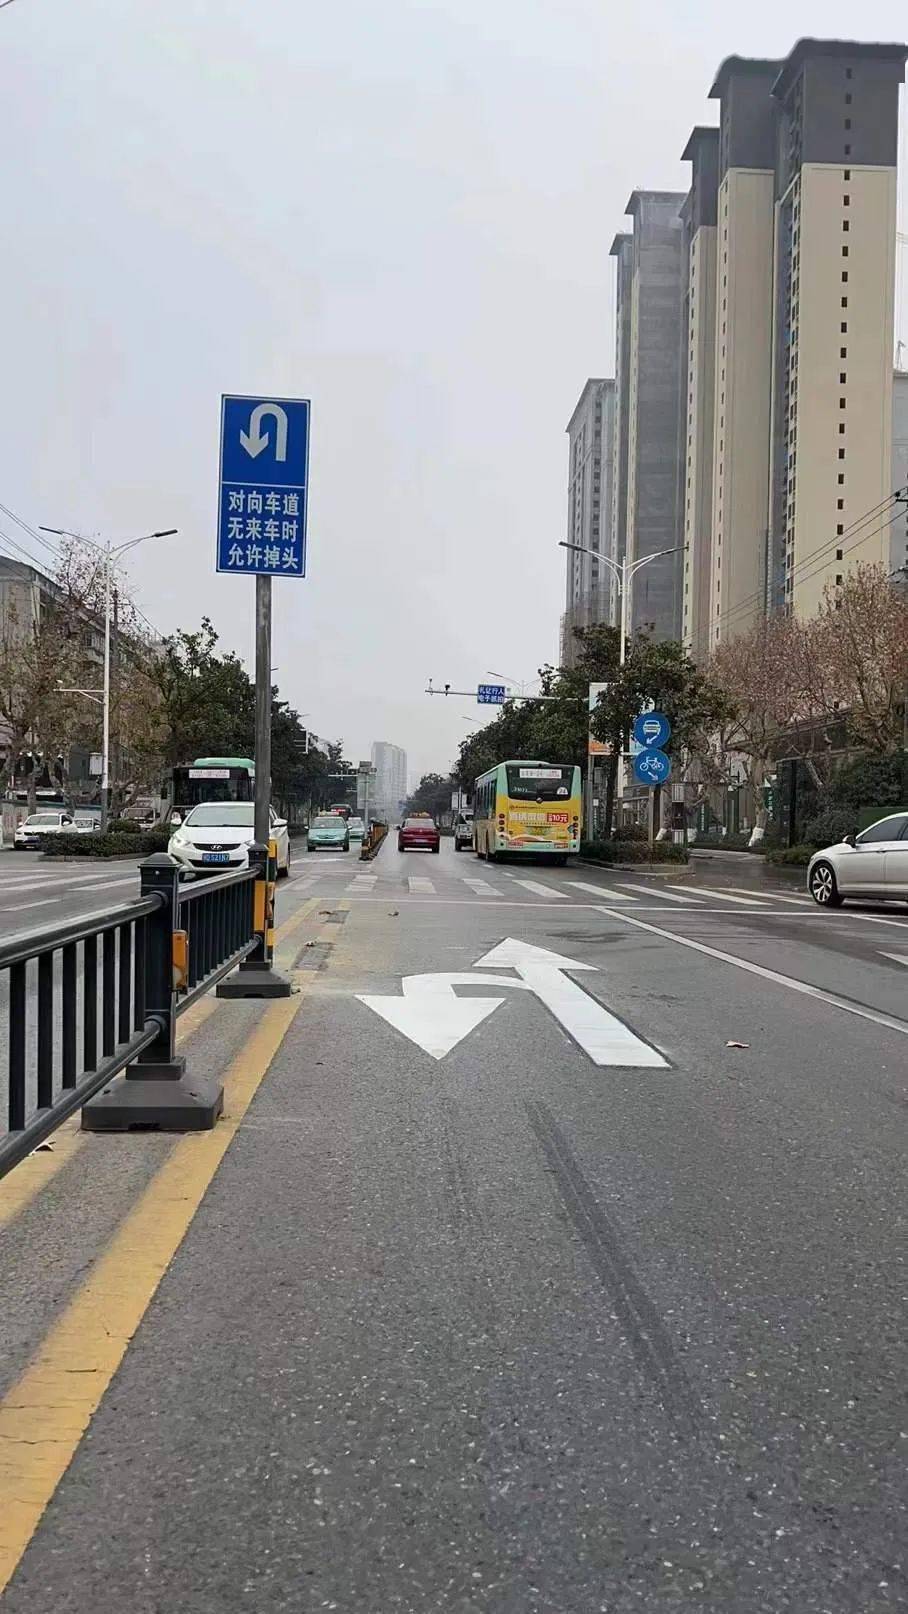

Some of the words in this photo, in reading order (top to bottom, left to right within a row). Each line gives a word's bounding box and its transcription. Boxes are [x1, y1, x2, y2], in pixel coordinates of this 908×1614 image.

[228, 489, 299, 516] 对向车道
[227, 517, 299, 543] 无来车时
[227, 543, 299, 569] 允许掉头
